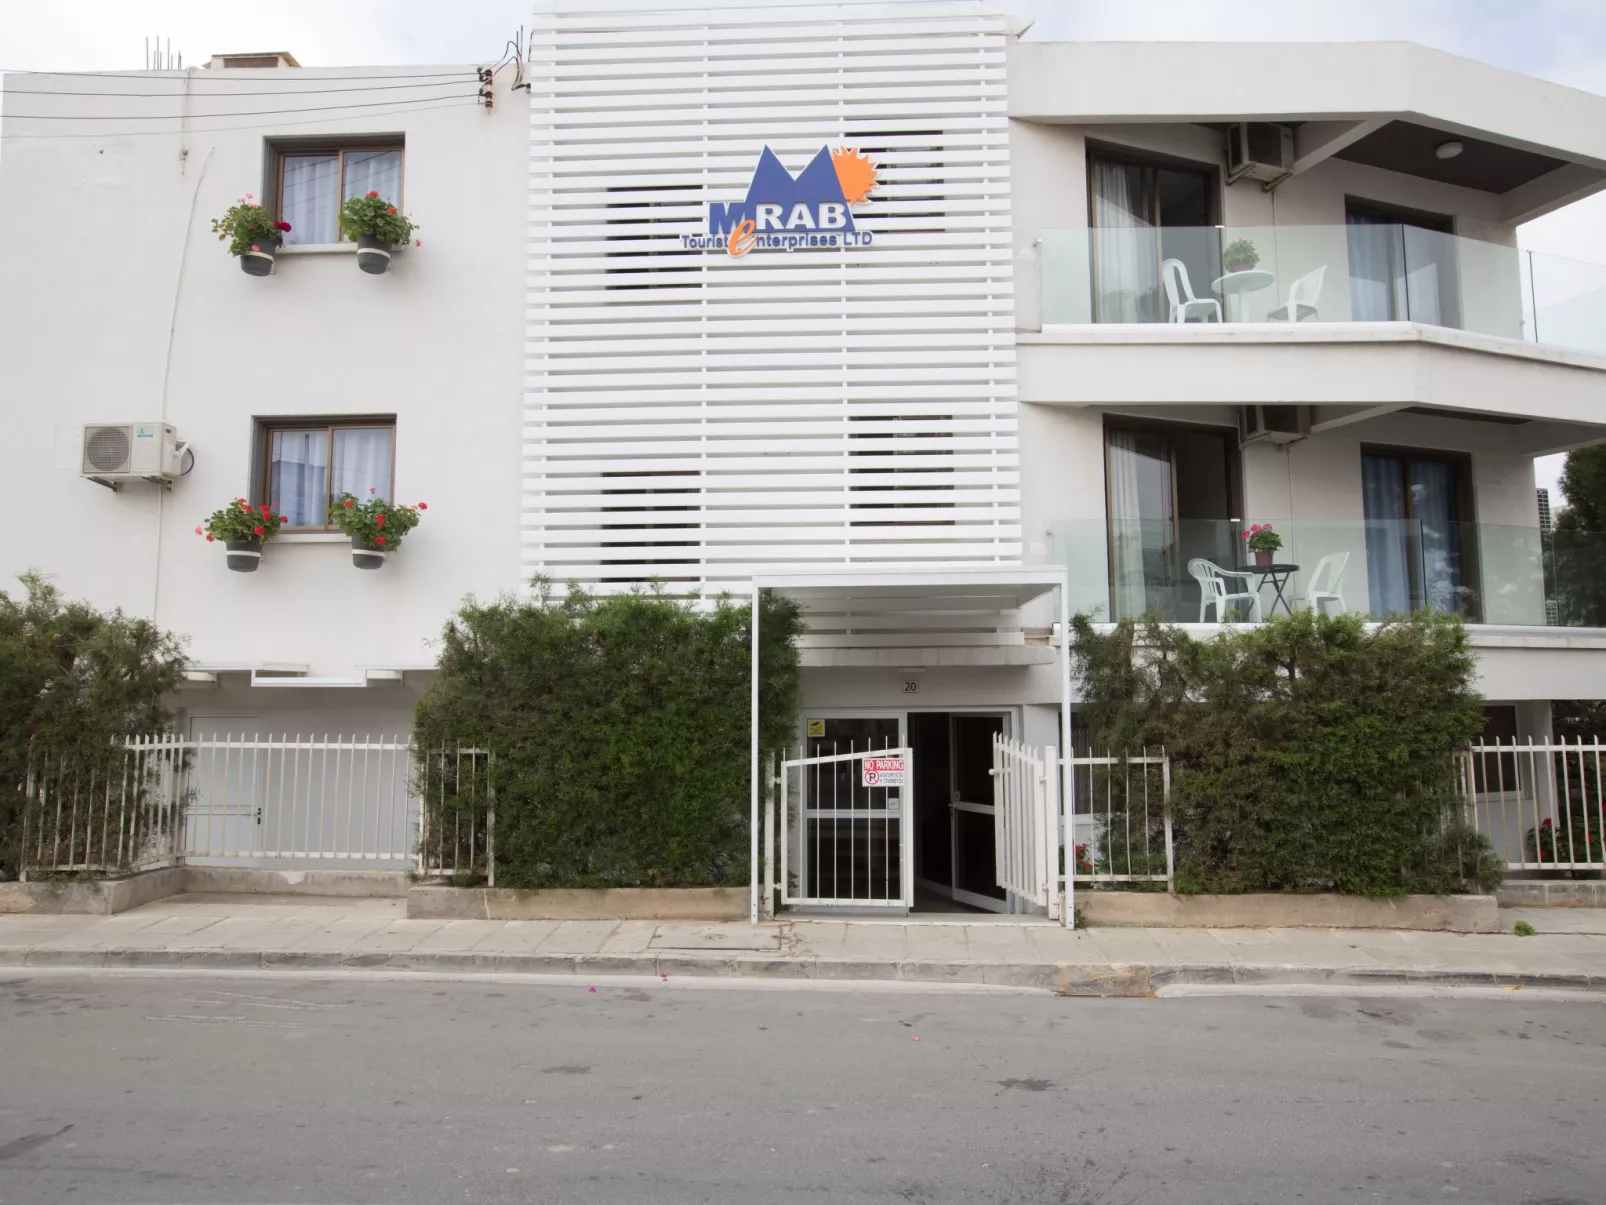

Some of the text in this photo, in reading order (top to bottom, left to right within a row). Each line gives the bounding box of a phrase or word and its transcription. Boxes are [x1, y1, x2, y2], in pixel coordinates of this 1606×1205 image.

[682, 235, 729, 248] Tourist
[843, 232, 872, 245] LTD
[904, 682, 917, 692] 20
[864, 760, 904, 770] NO PARKING
